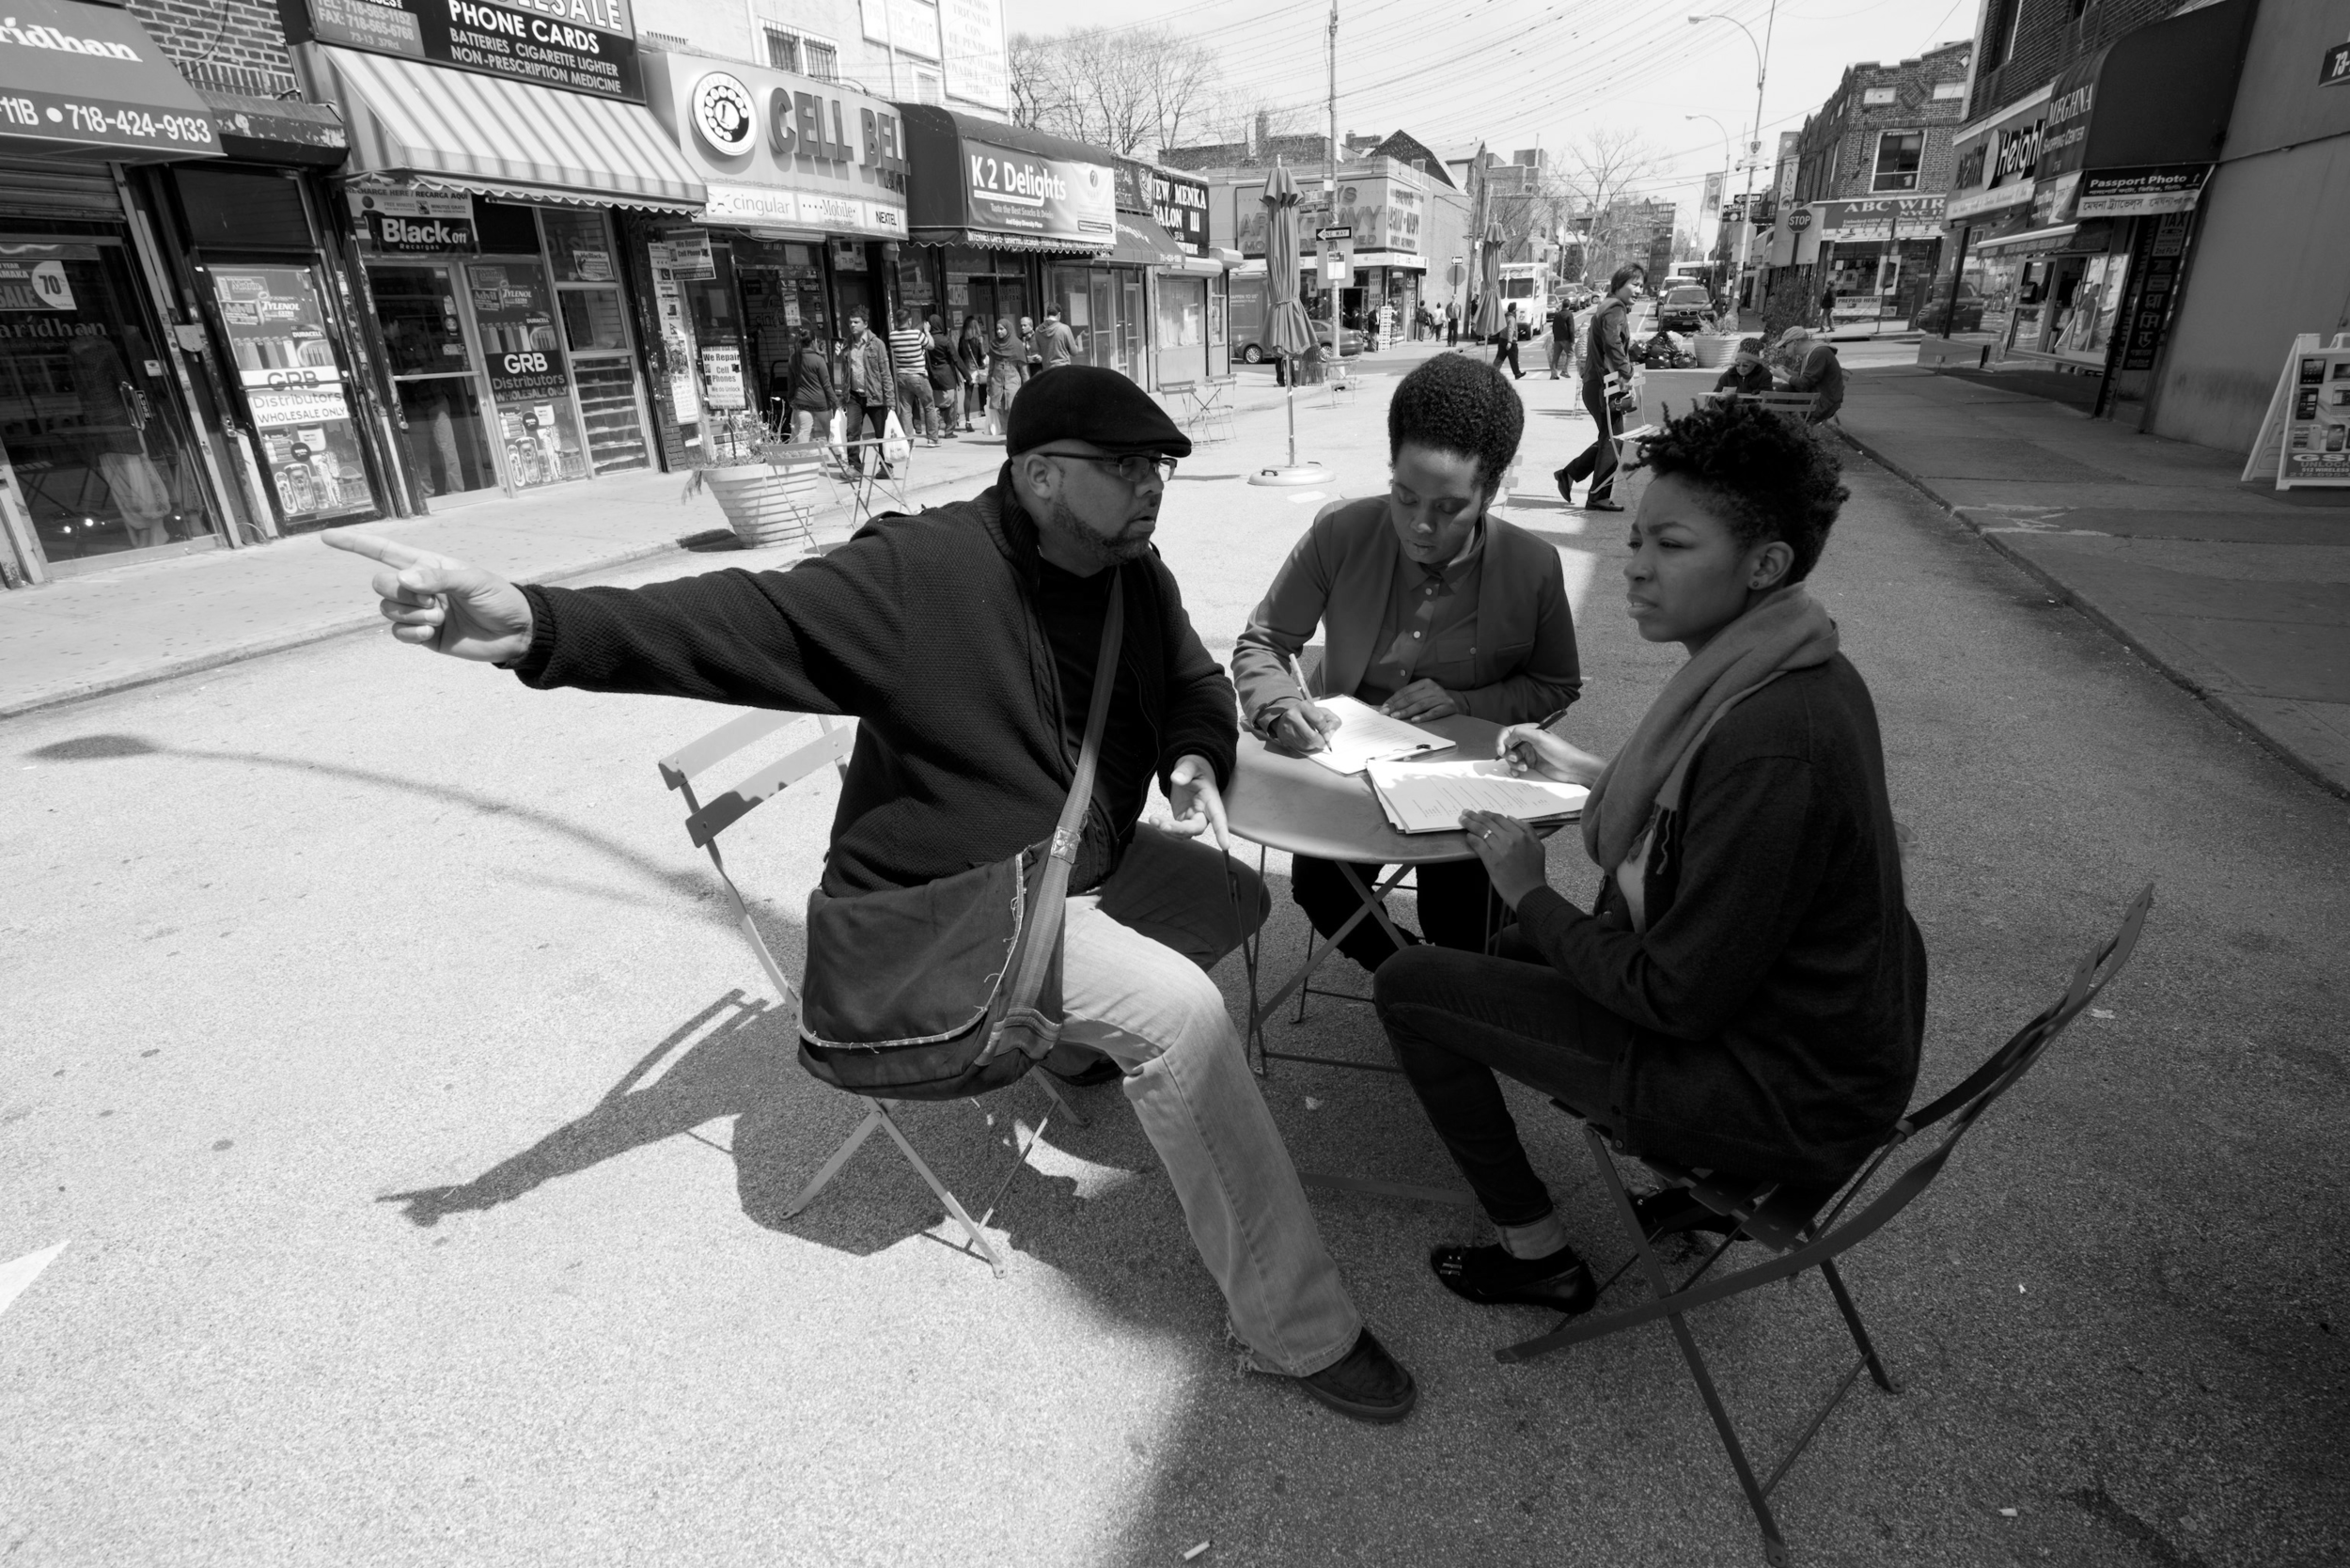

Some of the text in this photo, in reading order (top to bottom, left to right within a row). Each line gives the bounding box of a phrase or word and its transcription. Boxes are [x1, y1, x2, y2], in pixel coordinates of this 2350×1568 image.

[344, 0, 413, 26] 718-565-1152
[318, 8, 415, 41] FAX: 718-565-6768
[448, 0, 600, 54] PHONE CARDS
[349, 31, 375, 45] 73-13
[449, 27, 619, 77] BATTERIES CIGARETTE LIGHTER
[450, 45, 622, 93] NON-PRESCRIPTION MEDICINE
[2331, 50, 2350, 78] 73-
[2047, 86, 2092, 128] MEGHNA
[0, 96, 212, 143] 11B 718-424-9133
[769, 86, 911, 177] CELL BELL
[971, 154, 985, 188] K
[987, 158, 997, 190] 2
[1003, 161, 1066, 201] Delights
[2089, 175, 2187, 189] Passport Photo
[346, 187, 387, 196] RECHARGE
[415, 191, 448, 199] RECARGA
[1174, 183, 1207, 210] MENKA
[733, 193, 791, 217] cingular
[822, 199, 854, 219] Mobile
[990, 203, 1003, 213] Taste
[1002, 204, 1010, 214] the
[1010, 206, 1022, 215] Best
[1021, 207, 1037, 217] Snacks
[1844, 201, 1891, 213] ABC
[875, 211, 898, 227] NEXTEL
[1153, 204, 1183, 228] SALON
[1789, 215, 1811, 226] STOP
[2164, 212, 2187, 227] TAX
[382, 218, 467, 244] Black 011
[684, 240, 701, 248] Repair
[39, 274, 62, 295] 70
[475, 290, 498, 301] Advil
[502, 289, 532, 298] TYLENOL
[226, 303, 256, 314] Advil
[261, 301, 301, 311] TYLENOL
[504, 353, 548, 374] GRB
[702, 353, 741, 362] We Repair
[713, 374, 737, 383] Phones
[716, 366, 729, 374] Cell
[267, 370, 320, 391] GRB
[492, 374, 565, 390] Distributors
[253, 392, 342, 409] Distributors
[494, 385, 568, 402] WHOLESALE ONLY
[257, 406, 345, 423] WHOLESALE ONLY
[2293, 453, 2350, 462] GS
